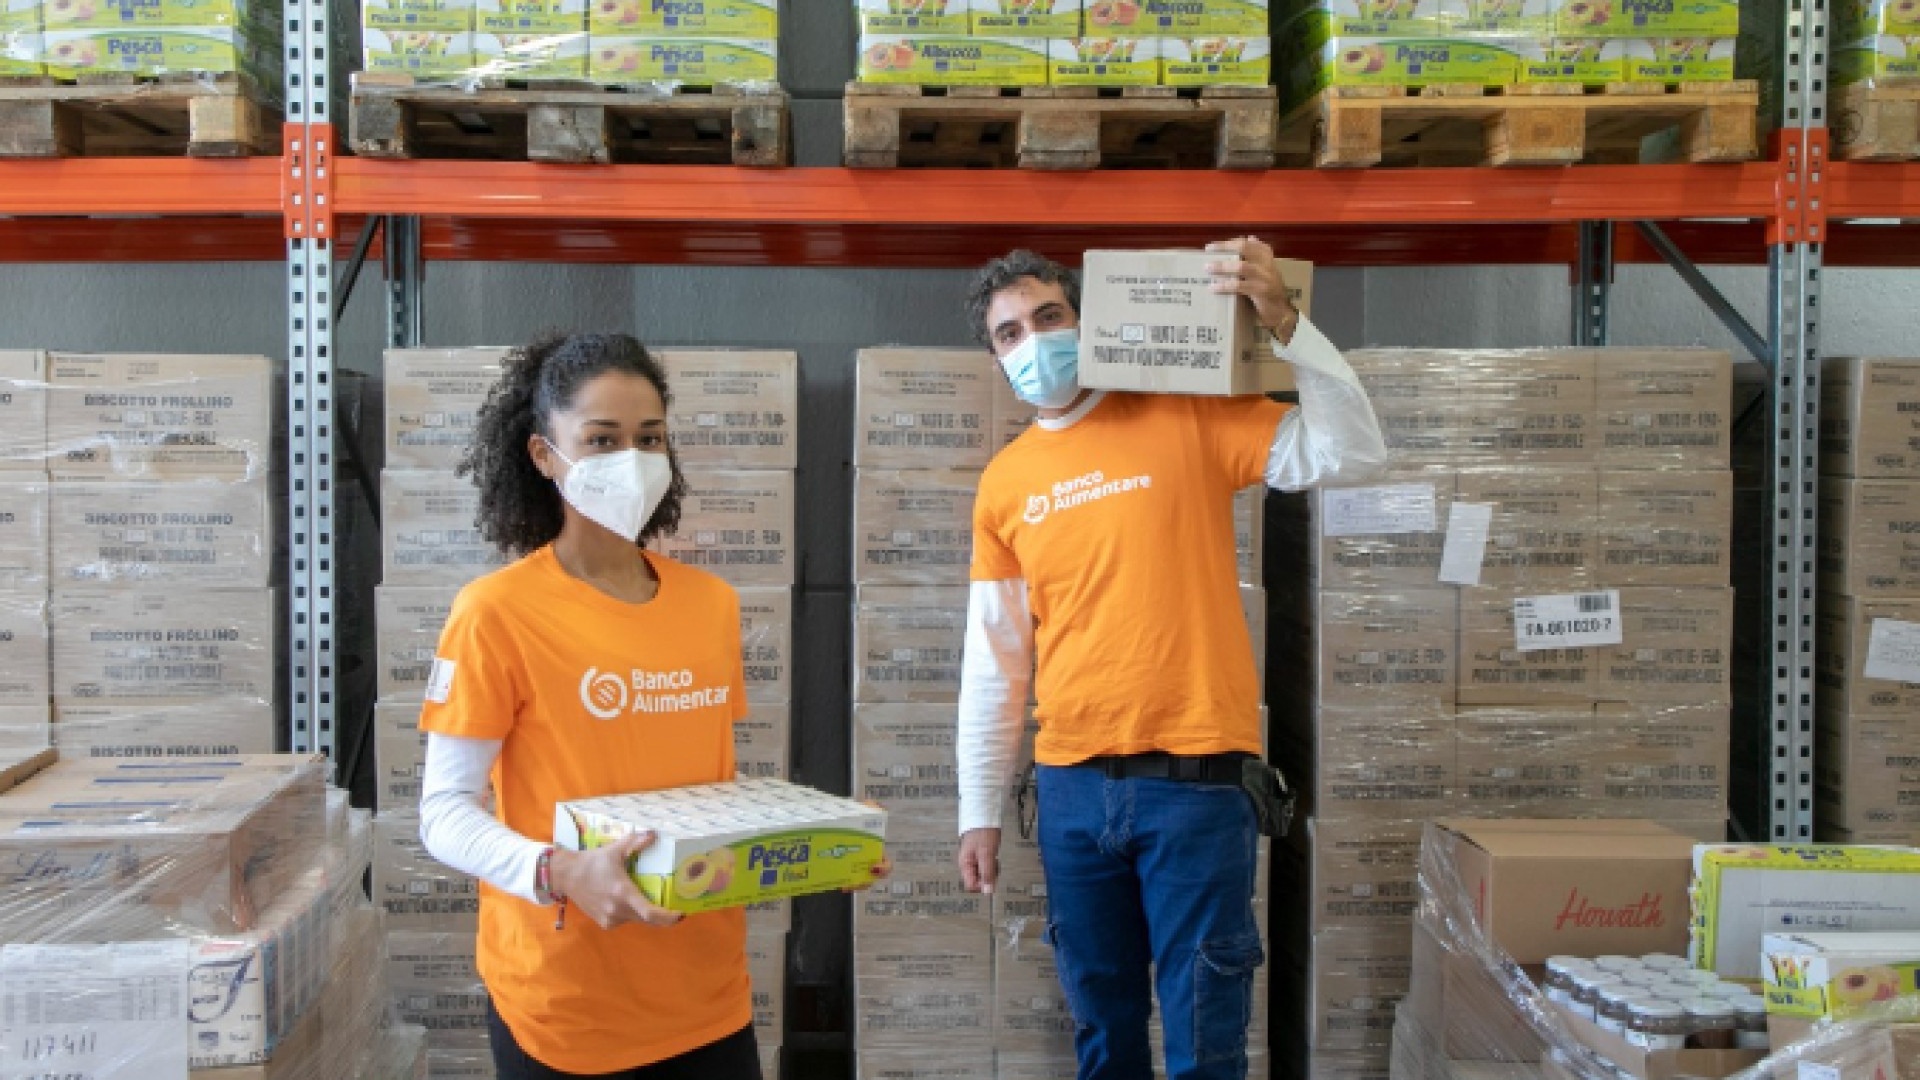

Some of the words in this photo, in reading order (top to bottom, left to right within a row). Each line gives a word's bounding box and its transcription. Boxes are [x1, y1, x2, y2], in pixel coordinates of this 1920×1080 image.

[108, 38, 162, 54] Pesca
[652, 45, 704, 62] Pesca
[1397, 45, 1450, 62] Pesca
[1051, 470, 1104, 497] Banco
[1054, 475, 1152, 512] Alimentare
[631, 668, 693, 690] Banco
[748, 843, 809, 870] Pesca
